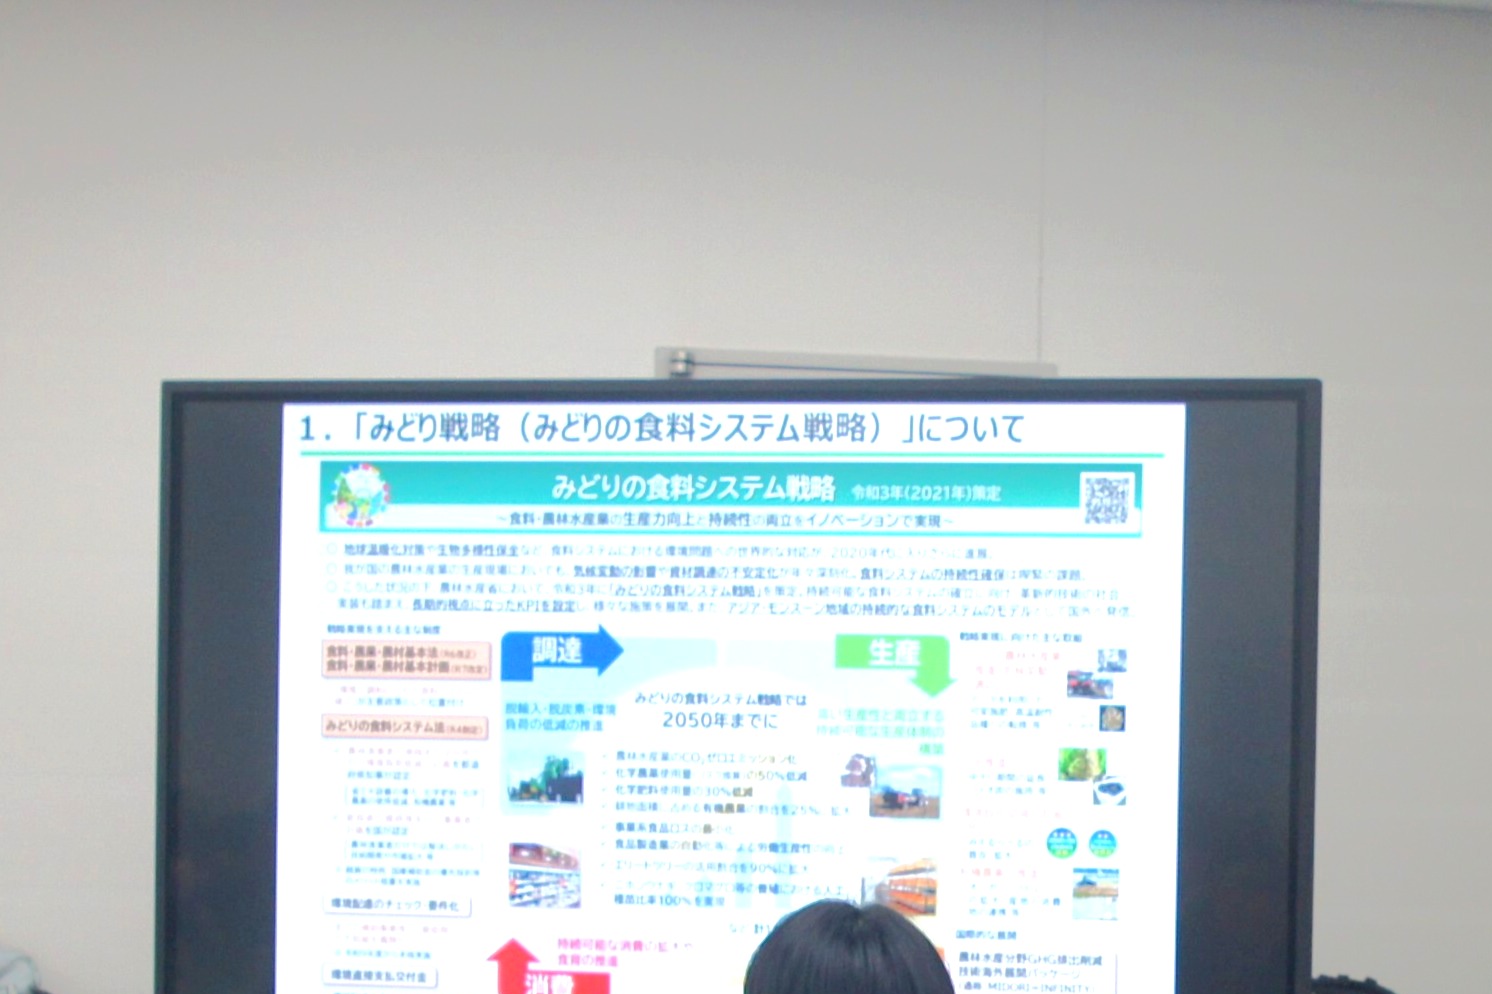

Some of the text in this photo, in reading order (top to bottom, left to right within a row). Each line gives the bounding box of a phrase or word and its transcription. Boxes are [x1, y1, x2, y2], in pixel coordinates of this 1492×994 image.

[551, 474, 837, 502] みどりの食料システム戦略
[532, 636, 582, 664] 調達
[869, 638, 920, 667] 生産
[634, 691, 807, 707] みどりの食料システム戦略では
[662, 711, 779, 730] 2050年までに
